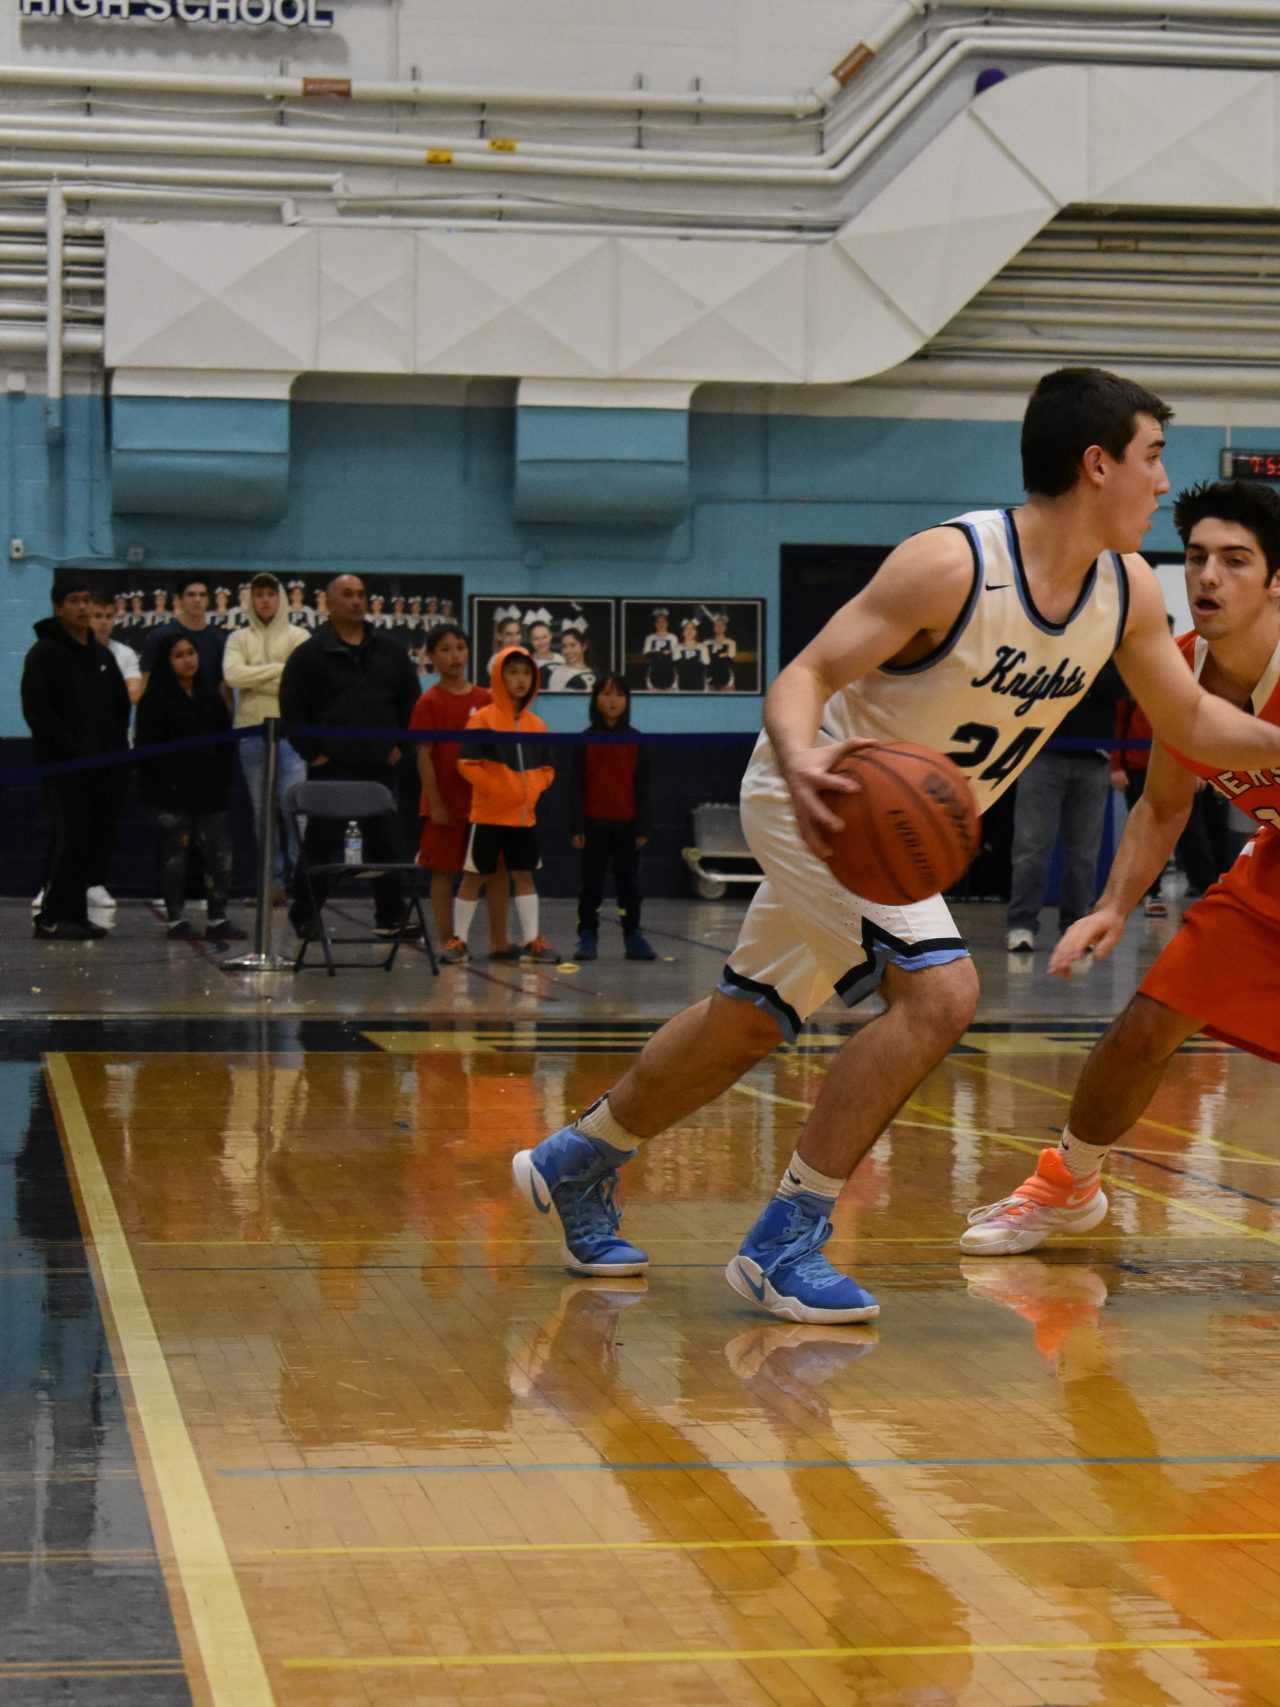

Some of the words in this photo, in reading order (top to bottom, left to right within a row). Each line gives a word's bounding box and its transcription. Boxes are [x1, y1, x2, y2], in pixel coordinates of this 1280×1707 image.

[144, 0, 334, 27] SCHOOL
[970, 645, 1086, 717] Knights
[945, 721, 1045, 790] 24
